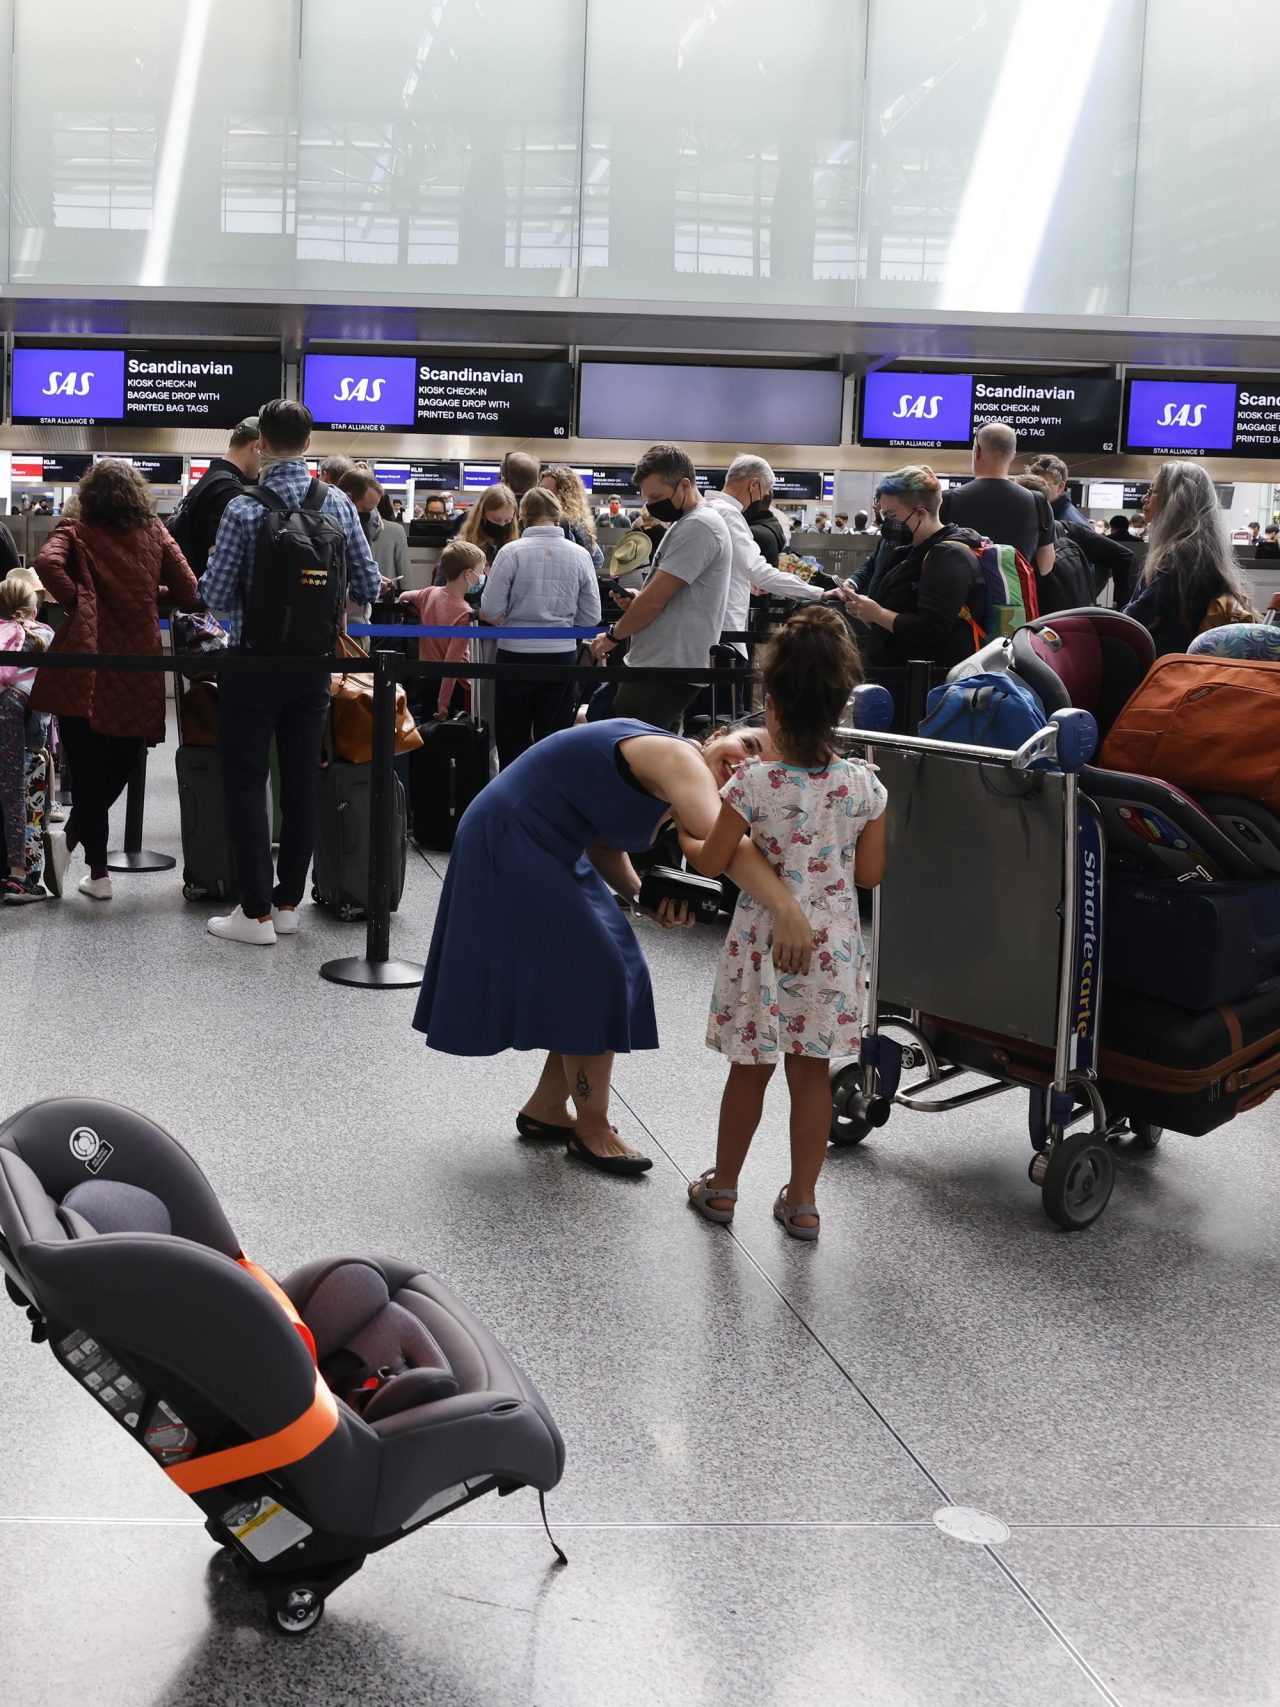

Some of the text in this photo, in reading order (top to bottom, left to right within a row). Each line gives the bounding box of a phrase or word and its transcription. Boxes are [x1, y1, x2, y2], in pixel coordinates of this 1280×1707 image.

[128, 359, 234, 375] Scandinavian
[420, 366, 524, 383] Scandinavian
[42, 371, 94, 396] SAS
[128, 379, 196, 388] KIOSK CHECK-IN
[334, 377, 386, 402] SAS
[419, 386, 487, 396] KIOSK CHECK-IN
[975, 384, 1075, 400] Scandinavian
[127, 392, 220, 401] BAGGAGE DROP WITH
[127, 404, 209, 413] PRINTED BAG TAGS
[418, 399, 510, 409] BAGGAGE DROP WITH
[892, 394, 943, 419] SAS
[974, 403, 1040, 412] KIOSK CHECK-IN
[418, 411, 498, 421] PRINTED BAG TAGS
[973, 415, 1062, 425] BAGGAGE DROP WITH
[1157, 403, 1207, 427] SAS
[1238, 411, 1262, 419] KIOSK
[554, 427, 564, 435] 60
[1014, 428, 1028, 436] AG
[1237, 423, 1276, 432] BAGGAGE
[1236, 435, 1271, 443] PRINTED
[1102, 443, 1113, 451] 62
